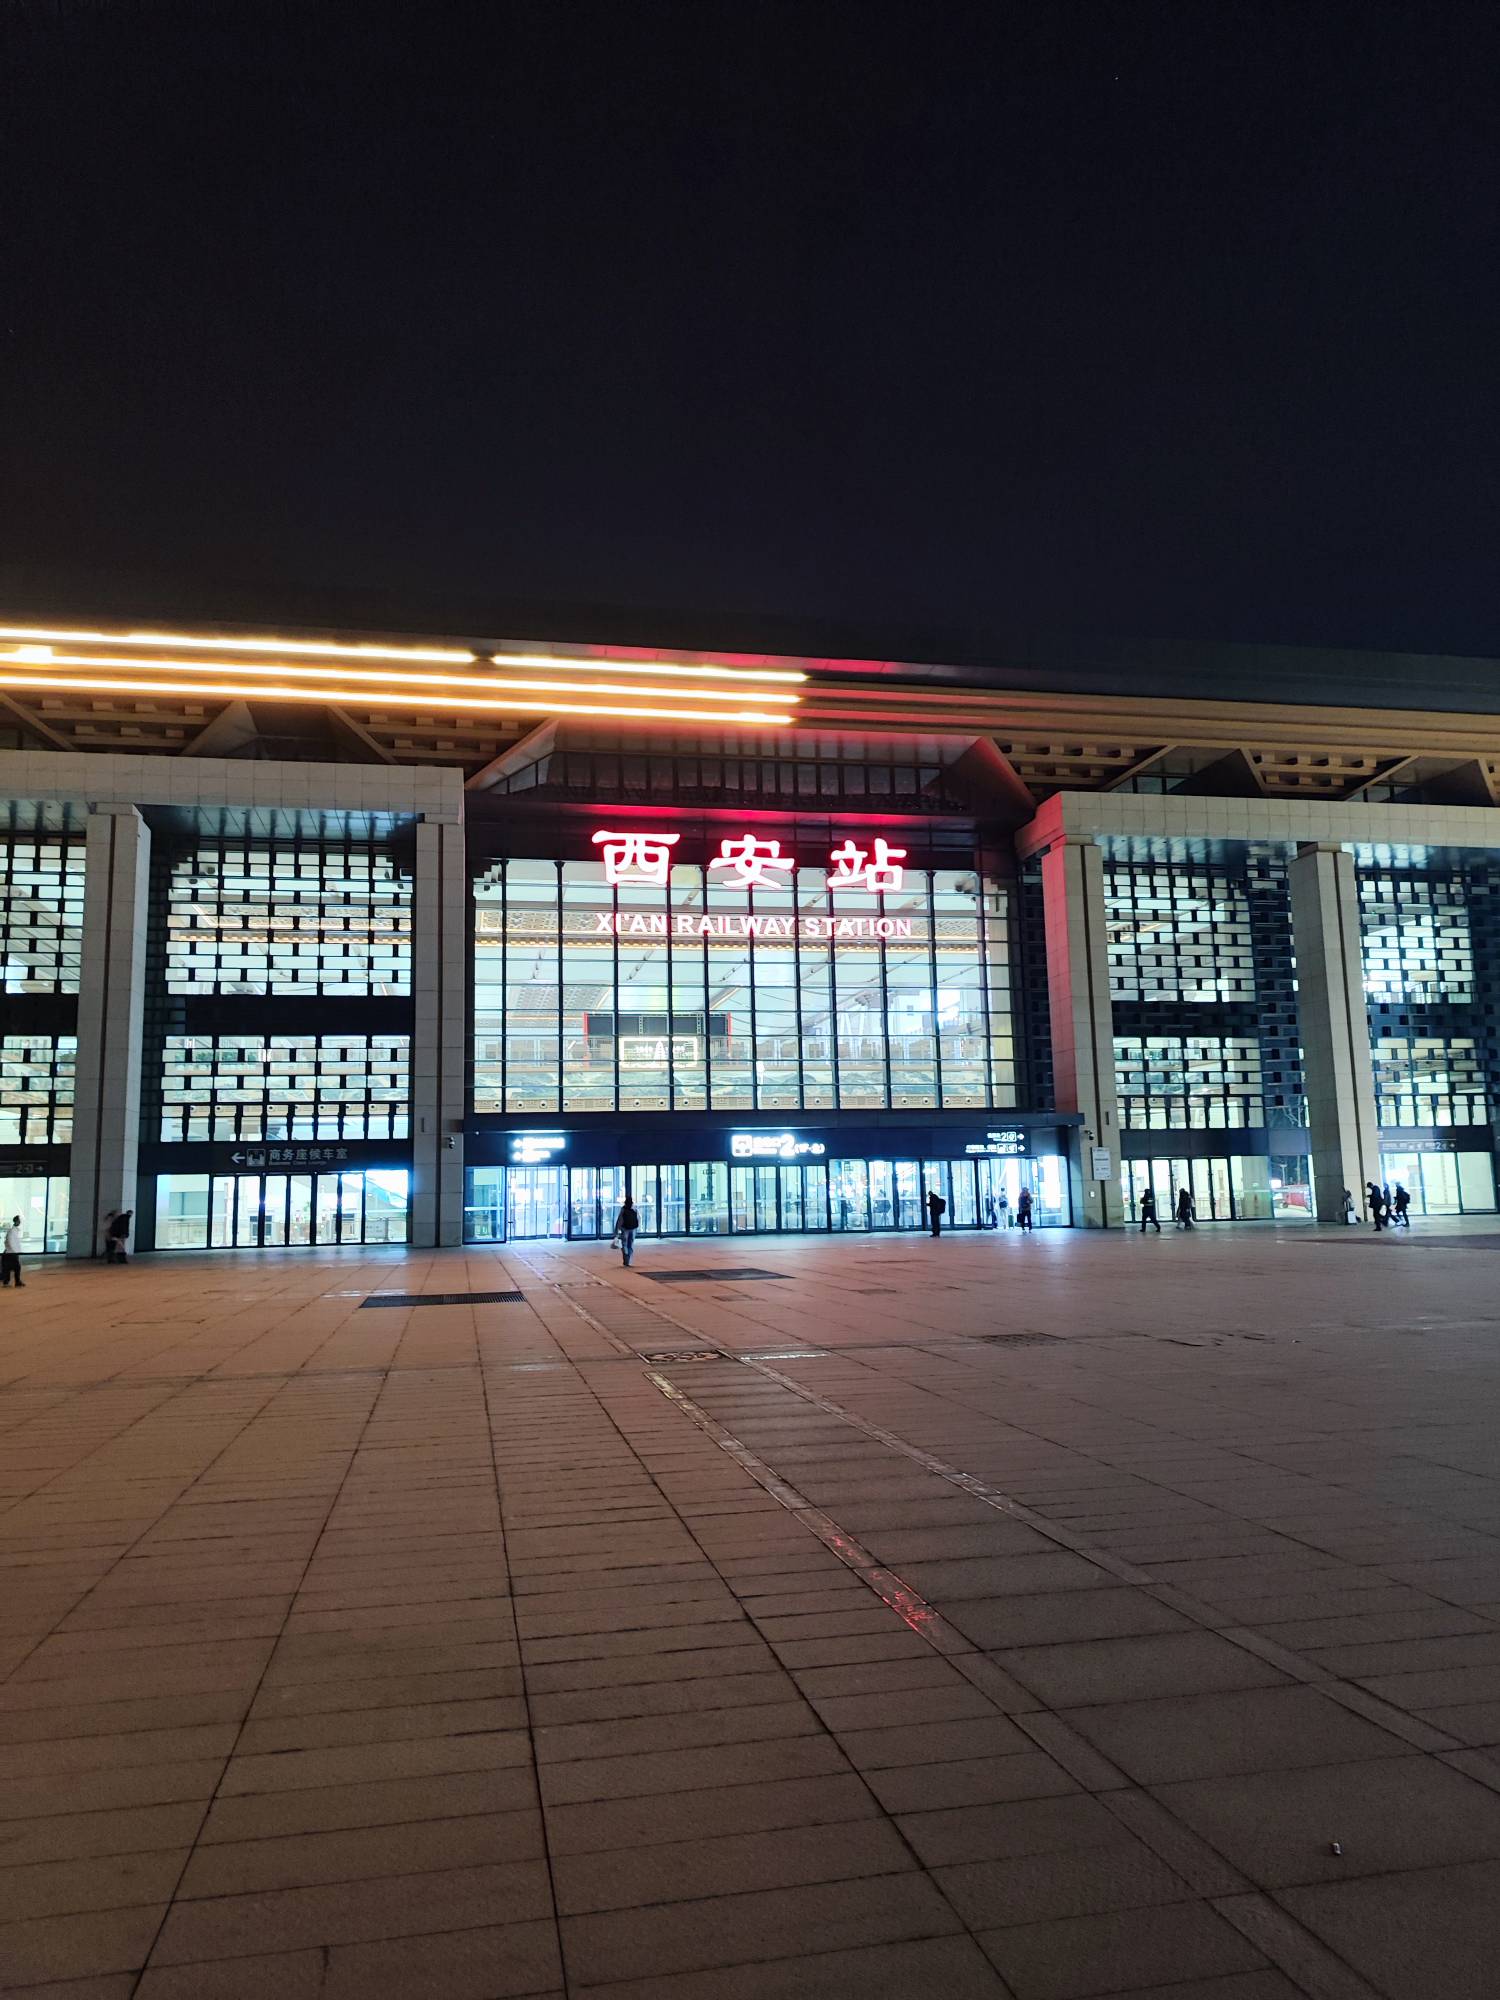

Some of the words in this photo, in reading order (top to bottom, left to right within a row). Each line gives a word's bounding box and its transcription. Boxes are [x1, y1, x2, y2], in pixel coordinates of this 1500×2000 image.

[591, 830, 907, 893] 西安站
[596, 913, 667, 934] XI'AN
[677, 914, 795, 936] RAILWAY
[805, 917, 911, 937] STATION
[269, 1148, 348, 1160] 商务座候车室
